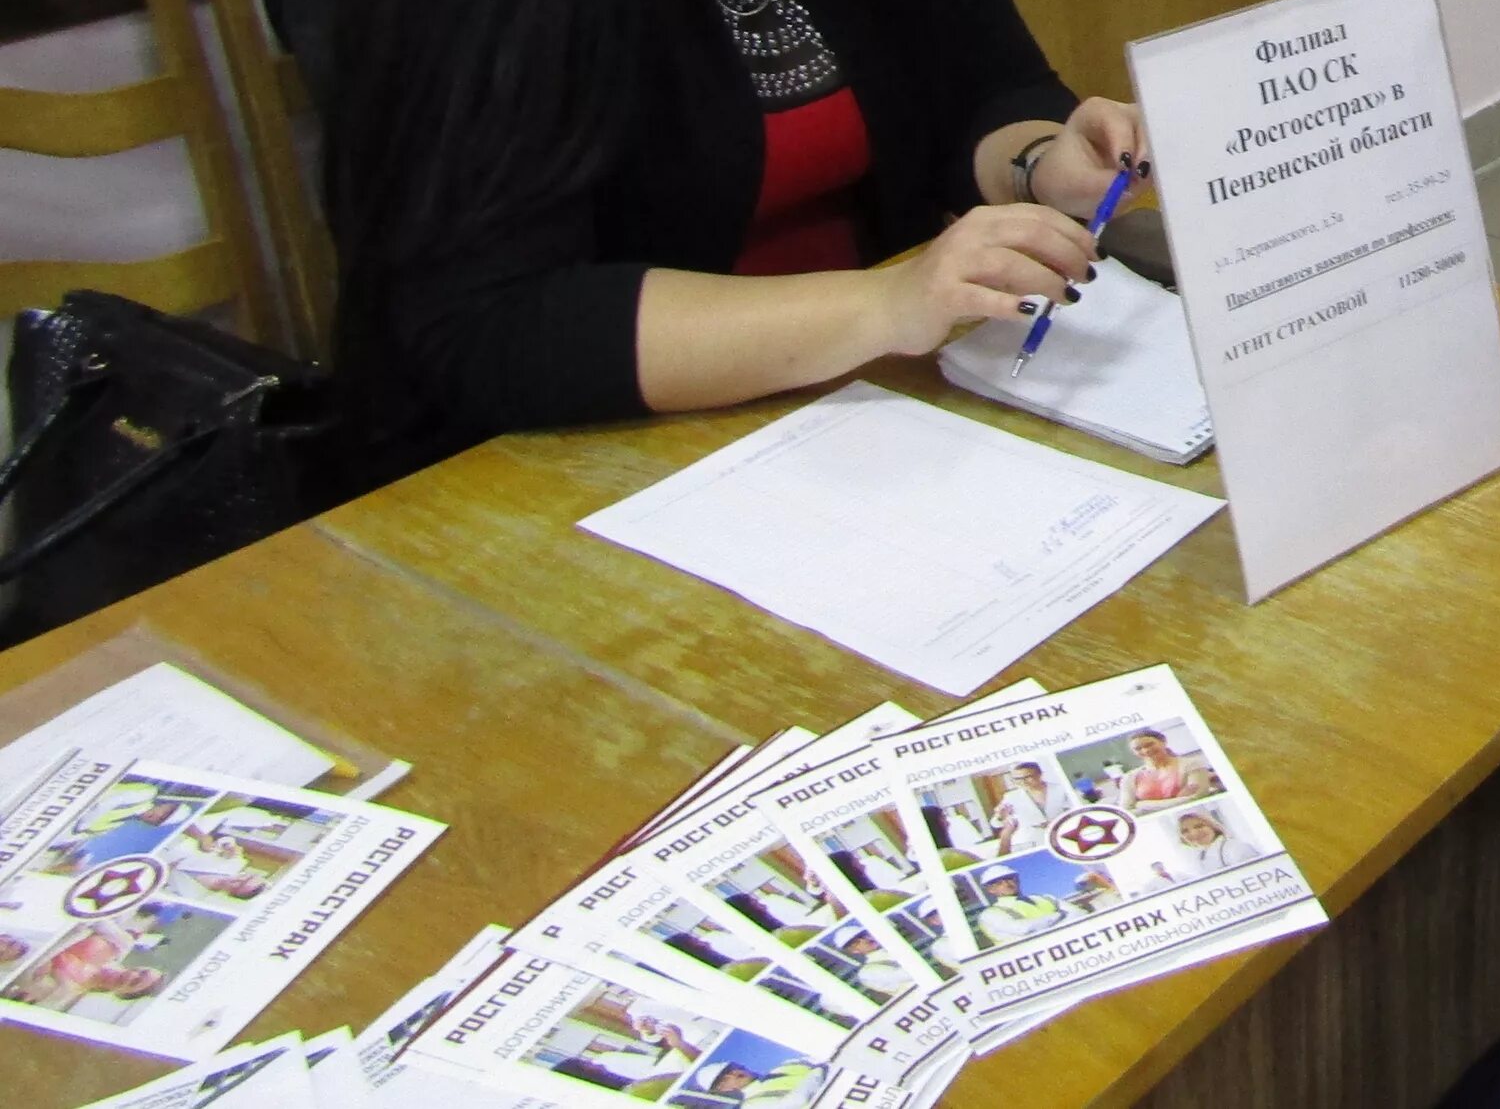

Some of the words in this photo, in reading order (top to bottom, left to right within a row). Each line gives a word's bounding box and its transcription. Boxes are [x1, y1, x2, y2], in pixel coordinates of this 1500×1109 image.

[1255, 23, 1348, 64] Филиал
[1258, 67, 1317, 105] ПАО
[1322, 52, 1361, 84] СК
[1206, 137, 1345, 204] Пензенской
[1350, 110, 1434, 155] области
[1225, 89, 1387, 156] «Росгосстрах»
[1392, 82, 1406, 101] в
[1222, 330, 1273, 364] АГЕНТ
[1276, 288, 1369, 341] СТРАХОВОЙ
[893, 702, 1069, 758] РОСГОССТРАХ
[905, 730, 1074, 785] ДОПОЛНИТЕЛЬНЫЙ
[1084, 711, 1145, 739] ДОХОД
[0, 762, 112, 868] РОСГОССТР
[268, 826, 417, 961] РОСГОССТРАХ
[978, 908, 1168, 985] РОСГОССТРАХ
[1172, 866, 1293, 918] КАРЬЕРА
[987, 980, 1035, 1003] ПОД
[1034, 951, 1116, 987] КРЫЛОМ
[1116, 917, 1207, 957] СИЛЬНОЙ
